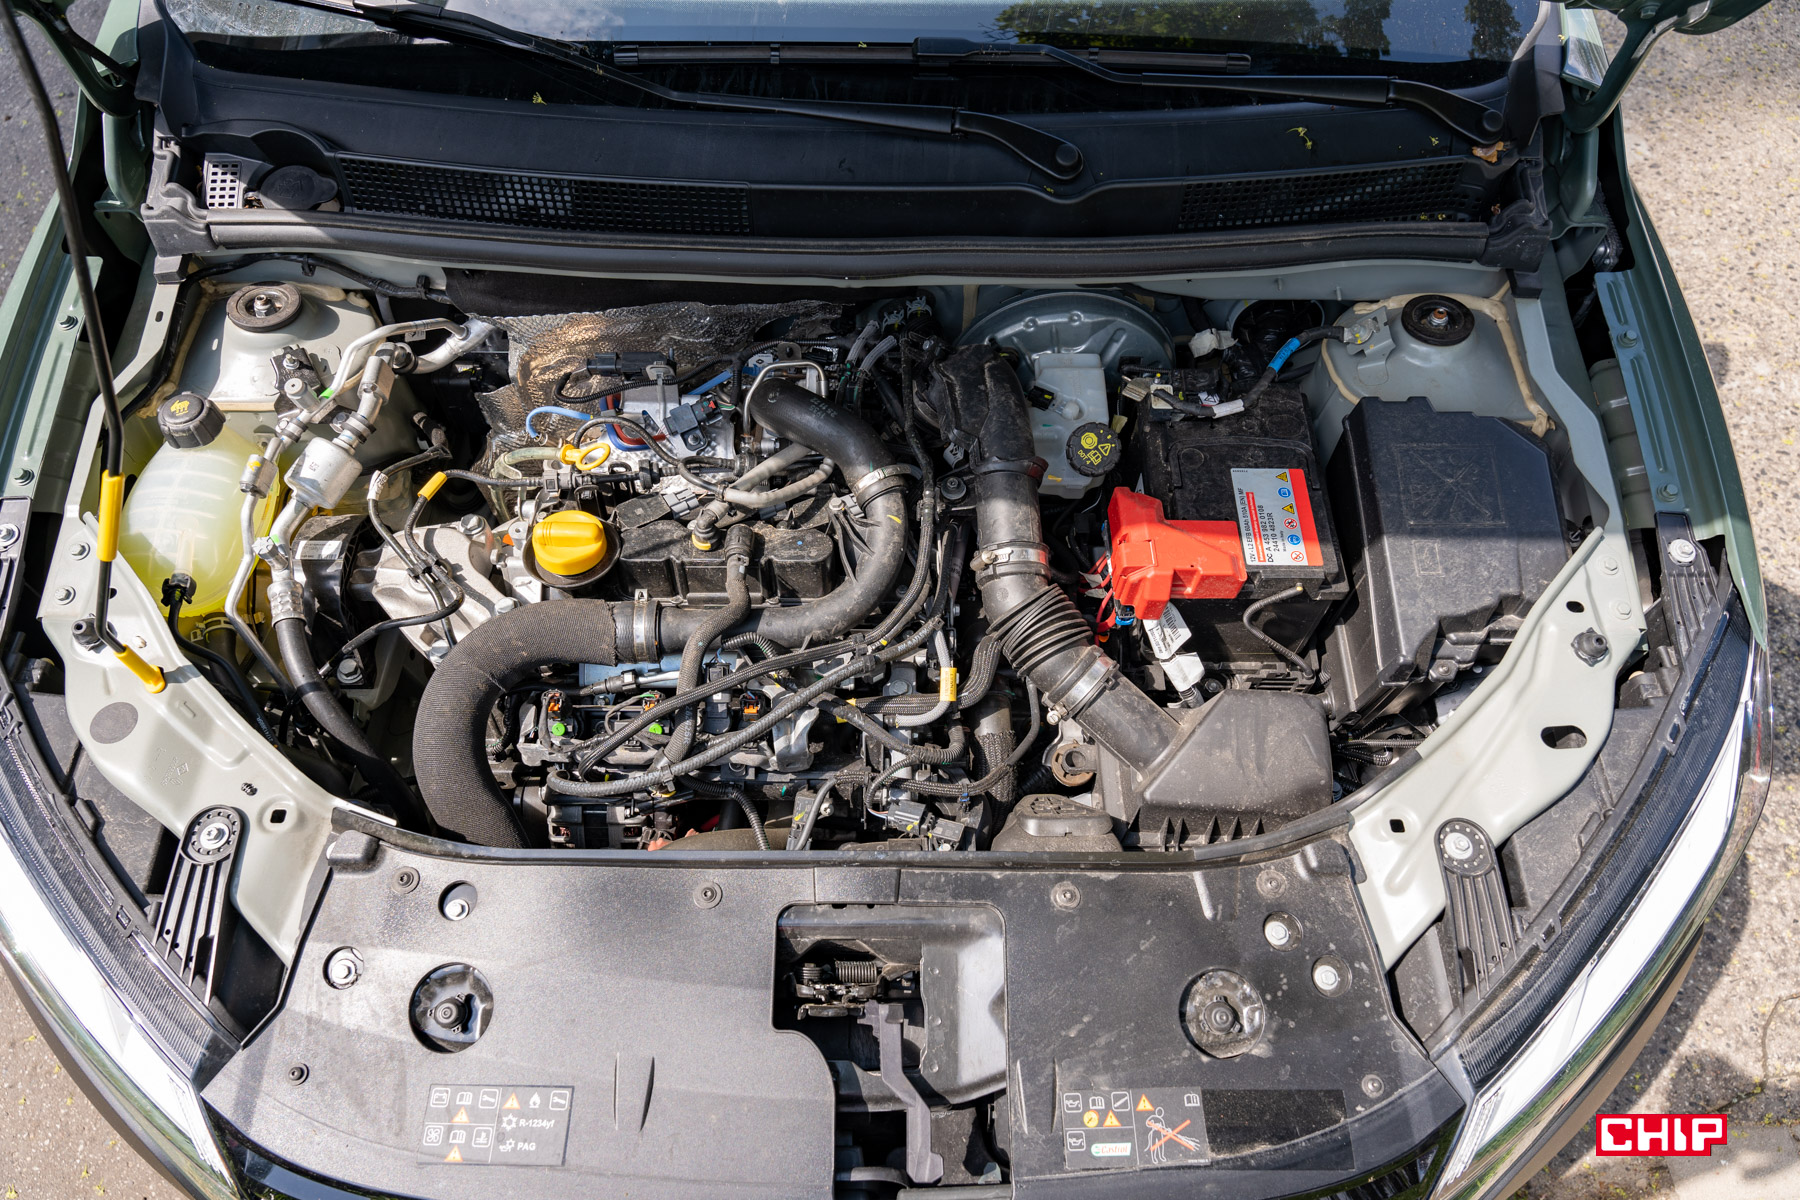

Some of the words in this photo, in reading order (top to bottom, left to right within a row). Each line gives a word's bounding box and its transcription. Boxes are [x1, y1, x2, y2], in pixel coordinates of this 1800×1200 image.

[1078, 450, 1088, 460] DOT
[1239, 496, 1247, 506] (EN)
[1258, 505, 1266, 519] 0108
[1267, 512, 1276, 532] 4823R
[1271, 534, 1280, 552] 24410
[1267, 553, 1274, 562] DC
[519, 1118, 555, 1129] R-1234yf
[517, 1142, 536, 1150] PAG
[1102, 1144, 1128, 1154] Castrol
